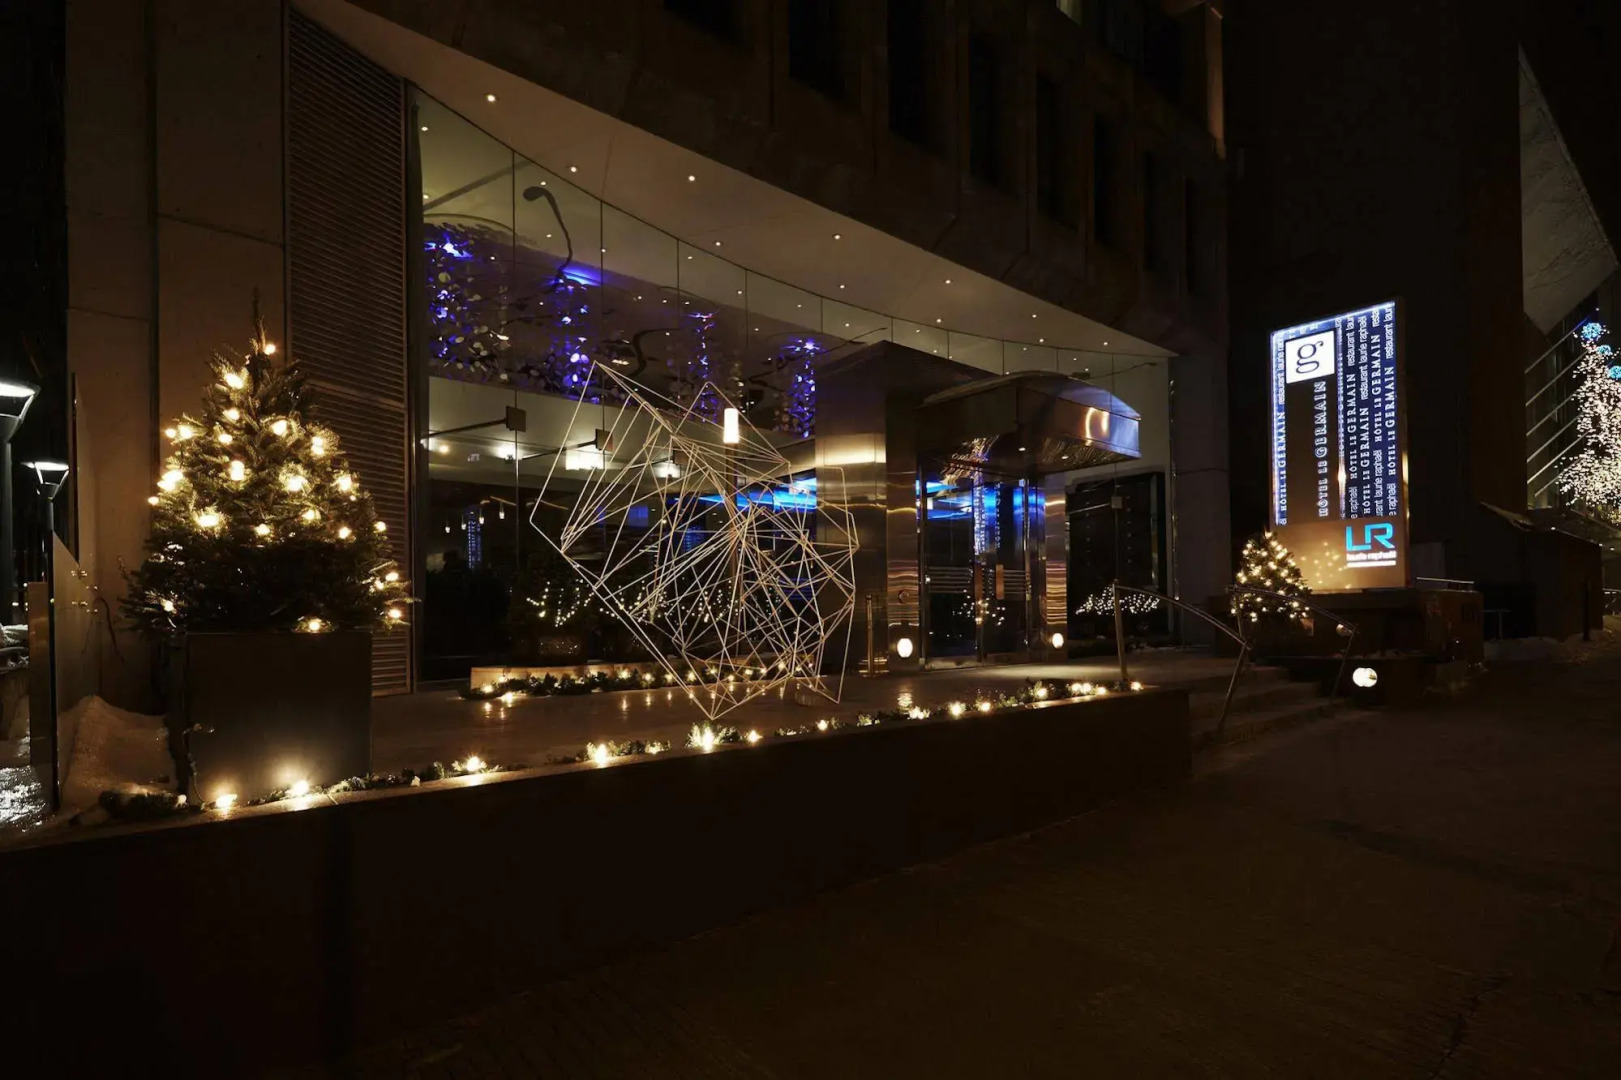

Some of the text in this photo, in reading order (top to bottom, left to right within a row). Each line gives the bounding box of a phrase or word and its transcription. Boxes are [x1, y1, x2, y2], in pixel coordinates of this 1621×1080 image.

[1296, 341, 1324, 374] g
[1346, 331, 1354, 366] restaurant
[1384, 323, 1393, 359] restaurant
[1359, 364, 1368, 400] restaurant
[1371, 334, 1381, 395] GERMAIN
[1346, 374, 1356, 433] GERMAIN
[1374, 398, 1381, 408] LE
[1384, 366, 1395, 428] GERMAIN
[1277, 411, 1286, 468] GERMAIN
[1314, 381, 1328, 517] HÔTEL LE GERMAIN
[1349, 436, 1356, 445] LE
[1360, 407, 1369, 468] GERMAIN
[1387, 430, 1395, 441] LE
[1362, 470, 1369, 480] LE
[1387, 444, 1395, 476] HÔTEL
[1346, 523, 1395, 551] LR
